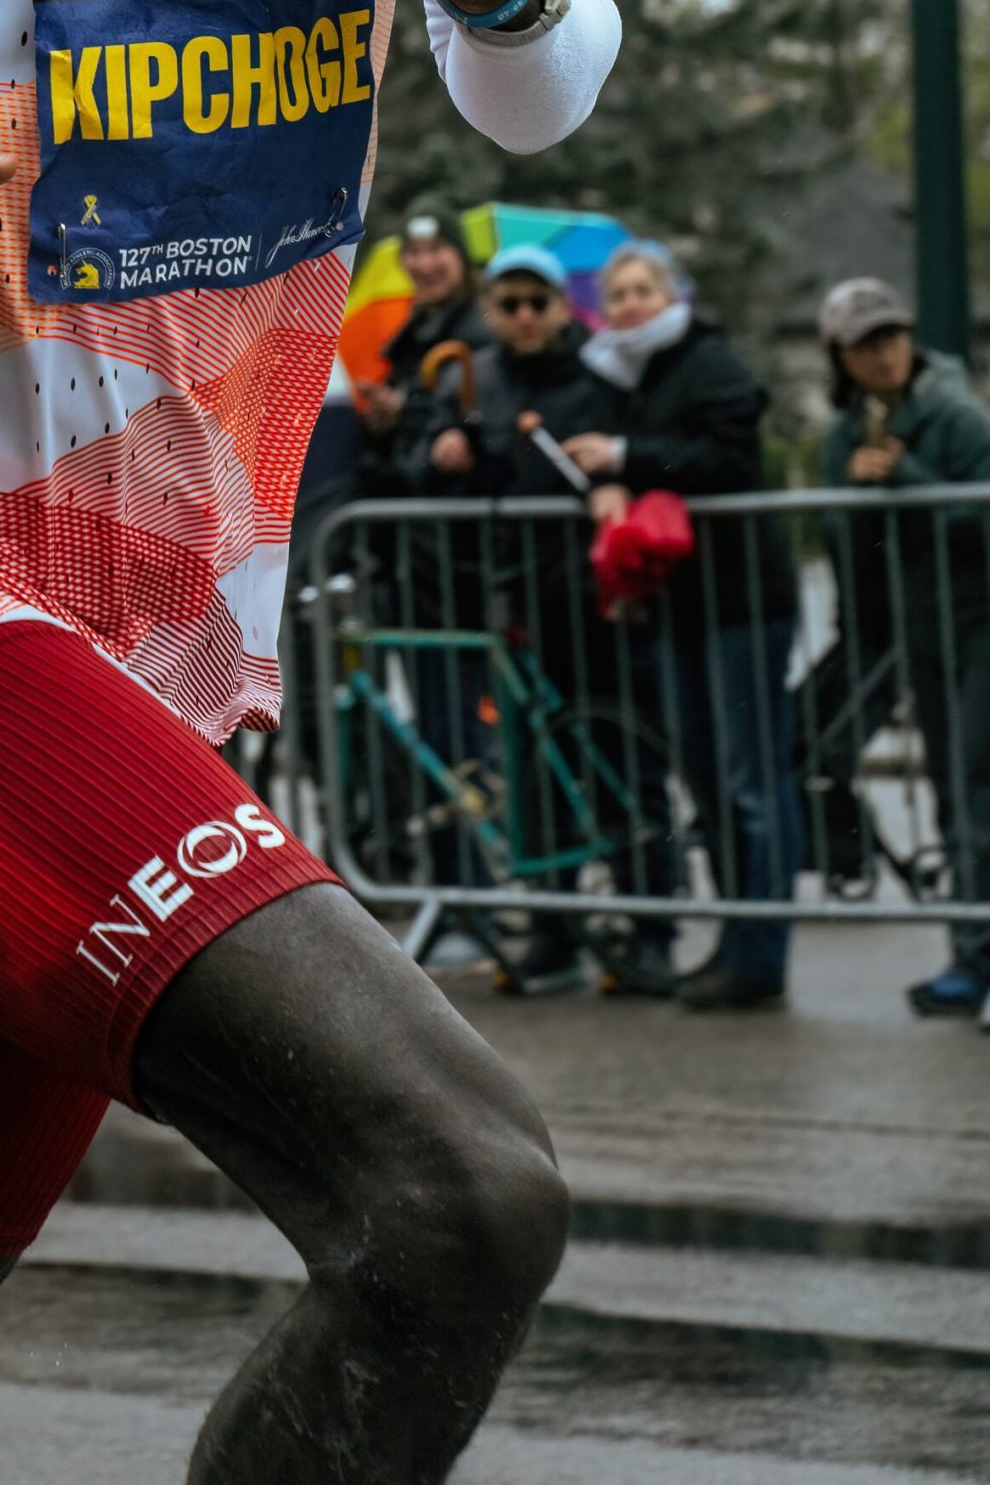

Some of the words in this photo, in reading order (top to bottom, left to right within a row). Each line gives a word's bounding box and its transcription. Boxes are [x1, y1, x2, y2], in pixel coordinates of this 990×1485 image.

[49, 9, 371, 145] KIPCHOGE
[119, 244, 164, 267] 127TH
[166, 235, 252, 259] BOSTON
[120, 255, 249, 289] MARATHON
[76, 803, 286, 987] INEOS
